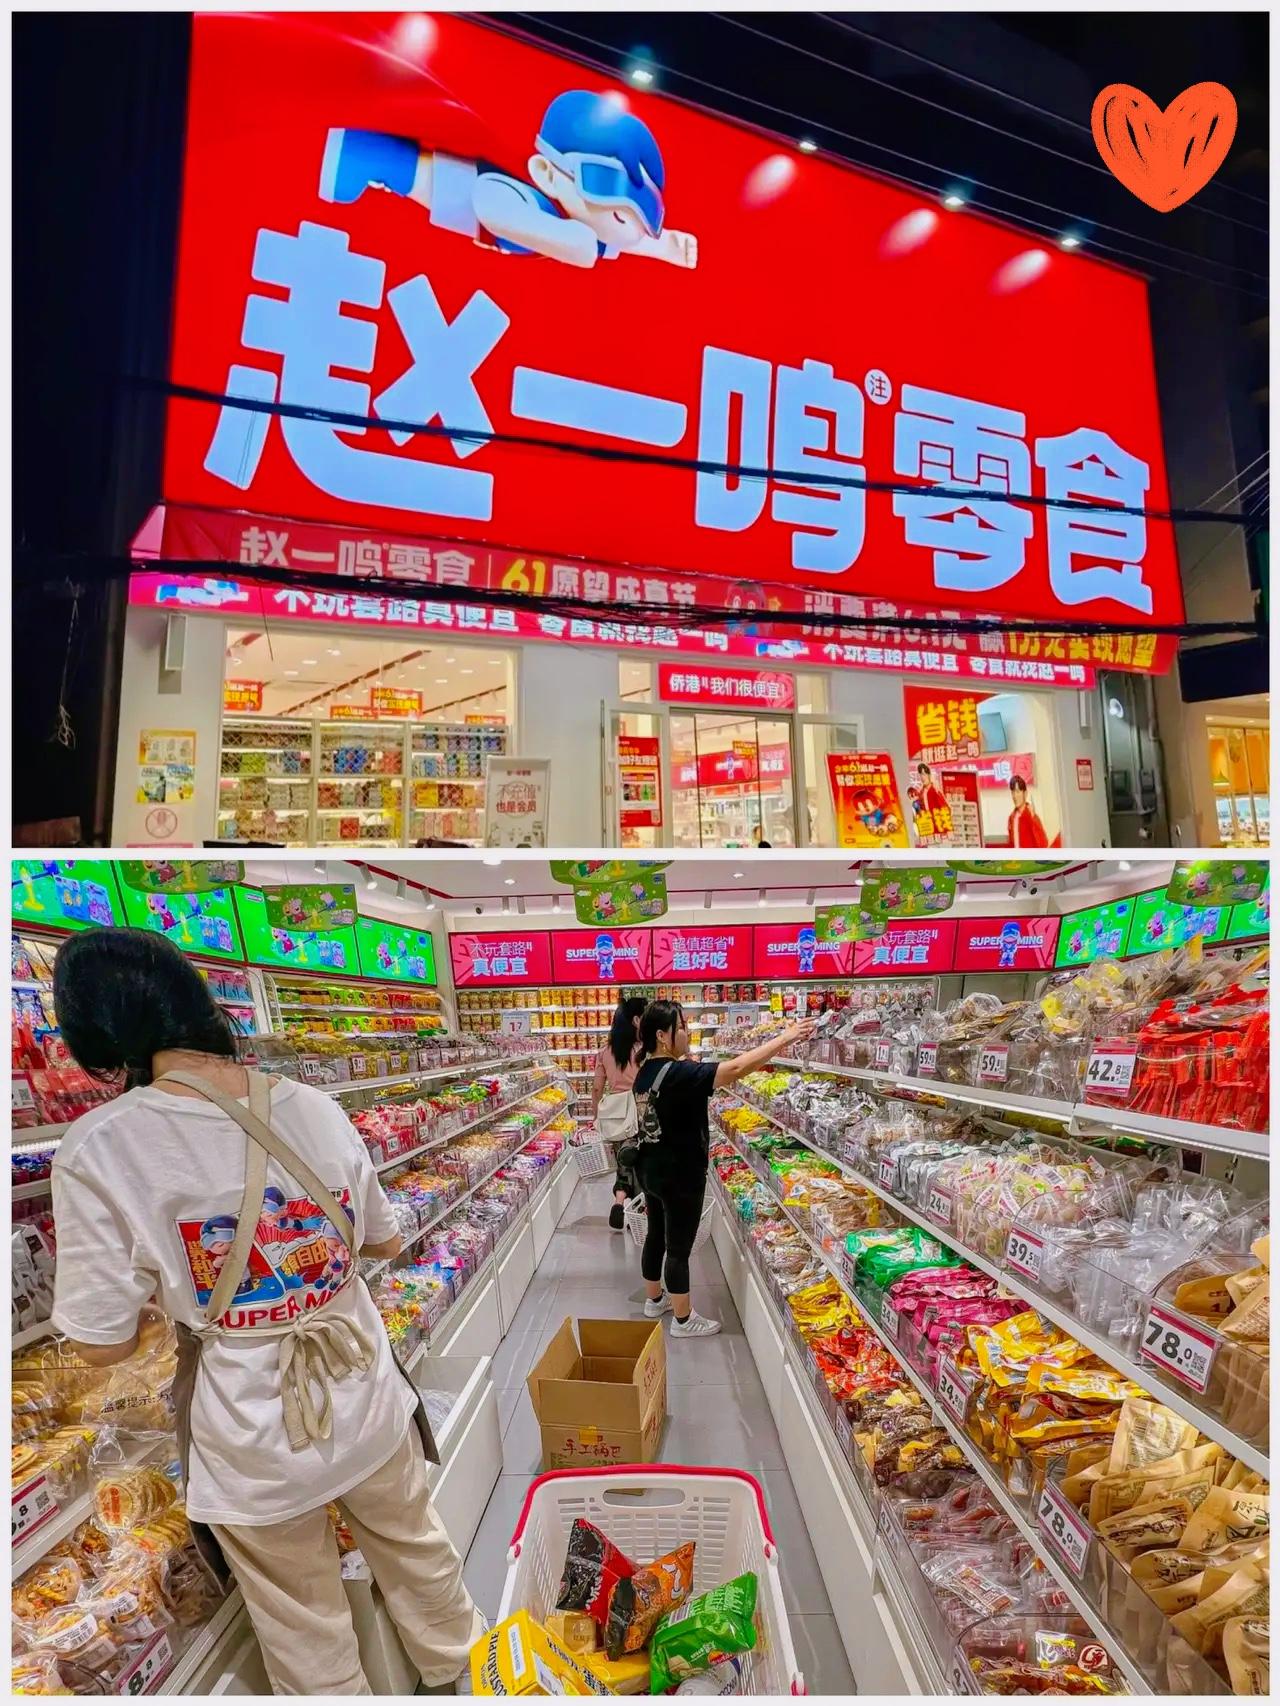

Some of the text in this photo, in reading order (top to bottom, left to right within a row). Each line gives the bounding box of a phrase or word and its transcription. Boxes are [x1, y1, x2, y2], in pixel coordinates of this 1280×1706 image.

[916, 697, 979, 745] 省钱
[766, 941, 841, 953] SUPER MING
[968, 934, 1044, 947] SUPER MING
[566, 946, 639, 959] SUPER MING
[672, 951, 729, 971] 超好吃
[872, 945, 929, 965] 真便宜
[473, 957, 528, 977] 真便宜
[1088, 1059, 1122, 1082] 42.8
[1009, 1238, 1034, 1265] 39.5
[217, 1296, 301, 1329] UPER
[1145, 1320, 1193, 1366] 78.0
[1041, 1495, 1073, 1546] 78.0
